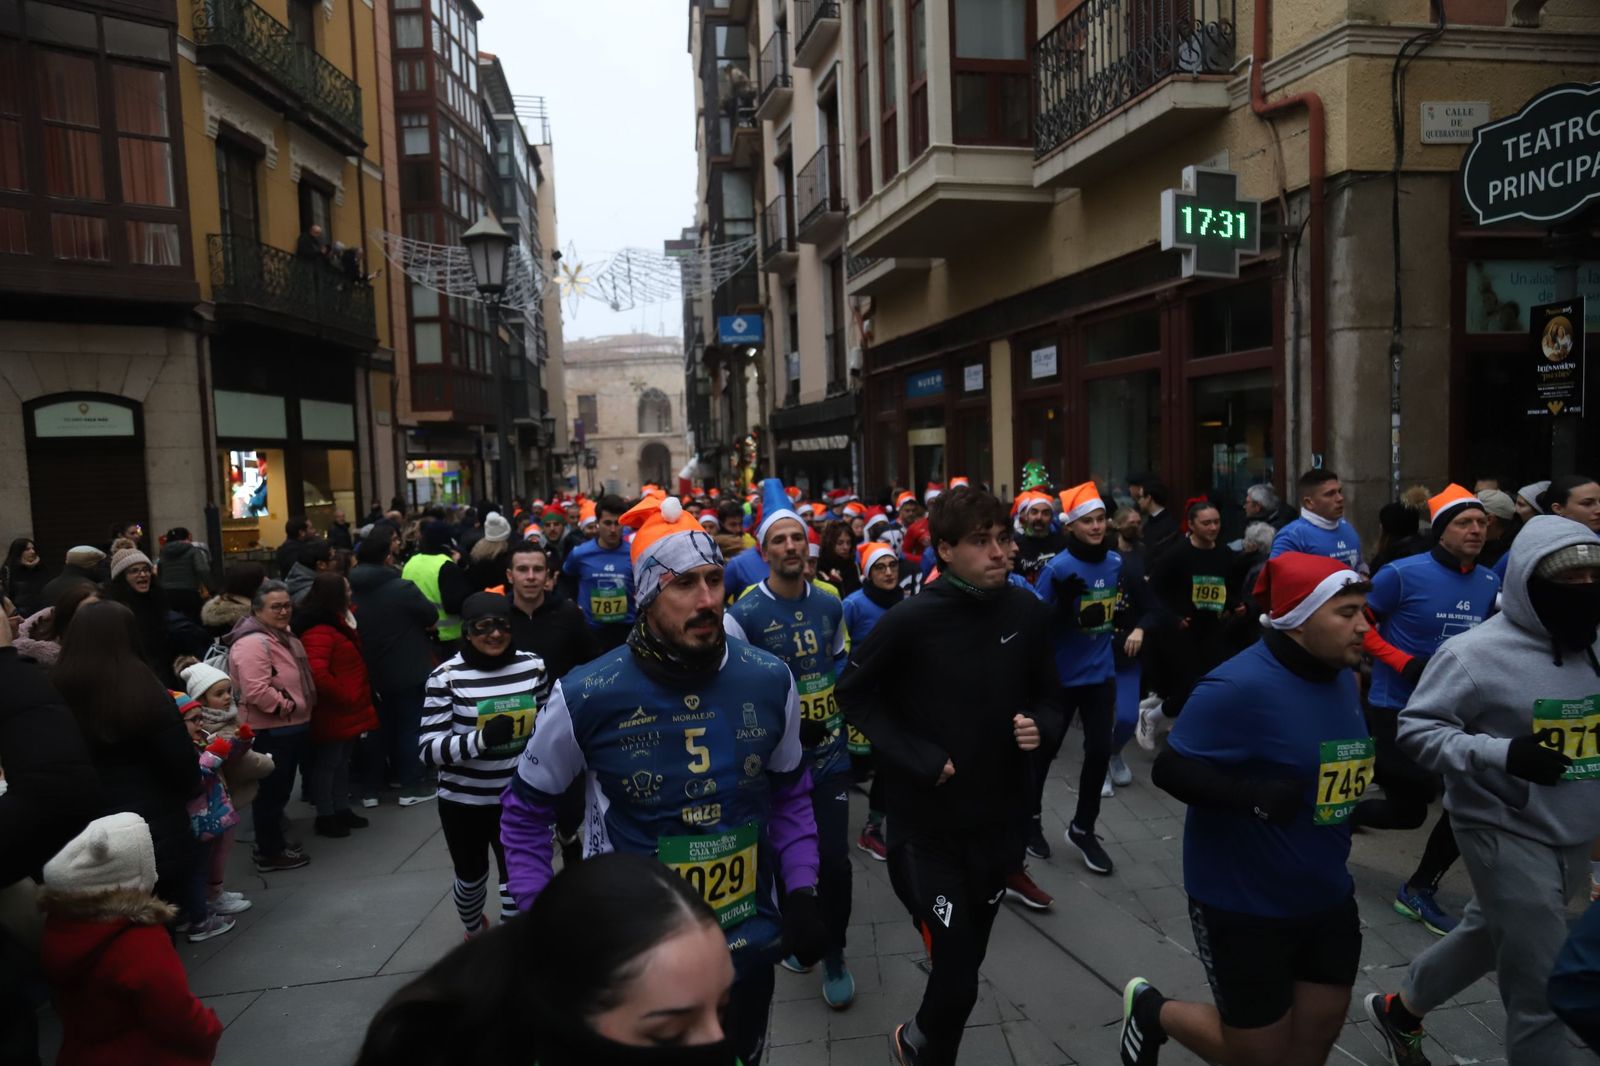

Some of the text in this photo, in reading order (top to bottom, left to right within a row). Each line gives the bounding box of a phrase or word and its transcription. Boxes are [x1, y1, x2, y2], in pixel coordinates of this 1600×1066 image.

[1445, 108, 1474, 117] CALLE
[1451, 119, 1463, 127] DE
[1489, 151, 1600, 205] PRINCIPA
[1181, 206, 1246, 239] 17:31
[1094, 578, 1105, 588] 46
[1196, 586, 1220, 600] 196
[594, 600, 622, 614] 787
[1456, 600, 1471, 611] 46
[792, 628, 819, 658] 19
[800, 693, 835, 720] 956
[618, 714, 658, 729] MERCURY
[672, 711, 716, 723] MORALEJO
[735, 728, 768, 740] ZAMORA
[683, 726, 711, 774] 5
[1323, 766, 1366, 802] 745
[712, 842, 737, 854] RURAL
[720, 901, 751, 924] RURAL
